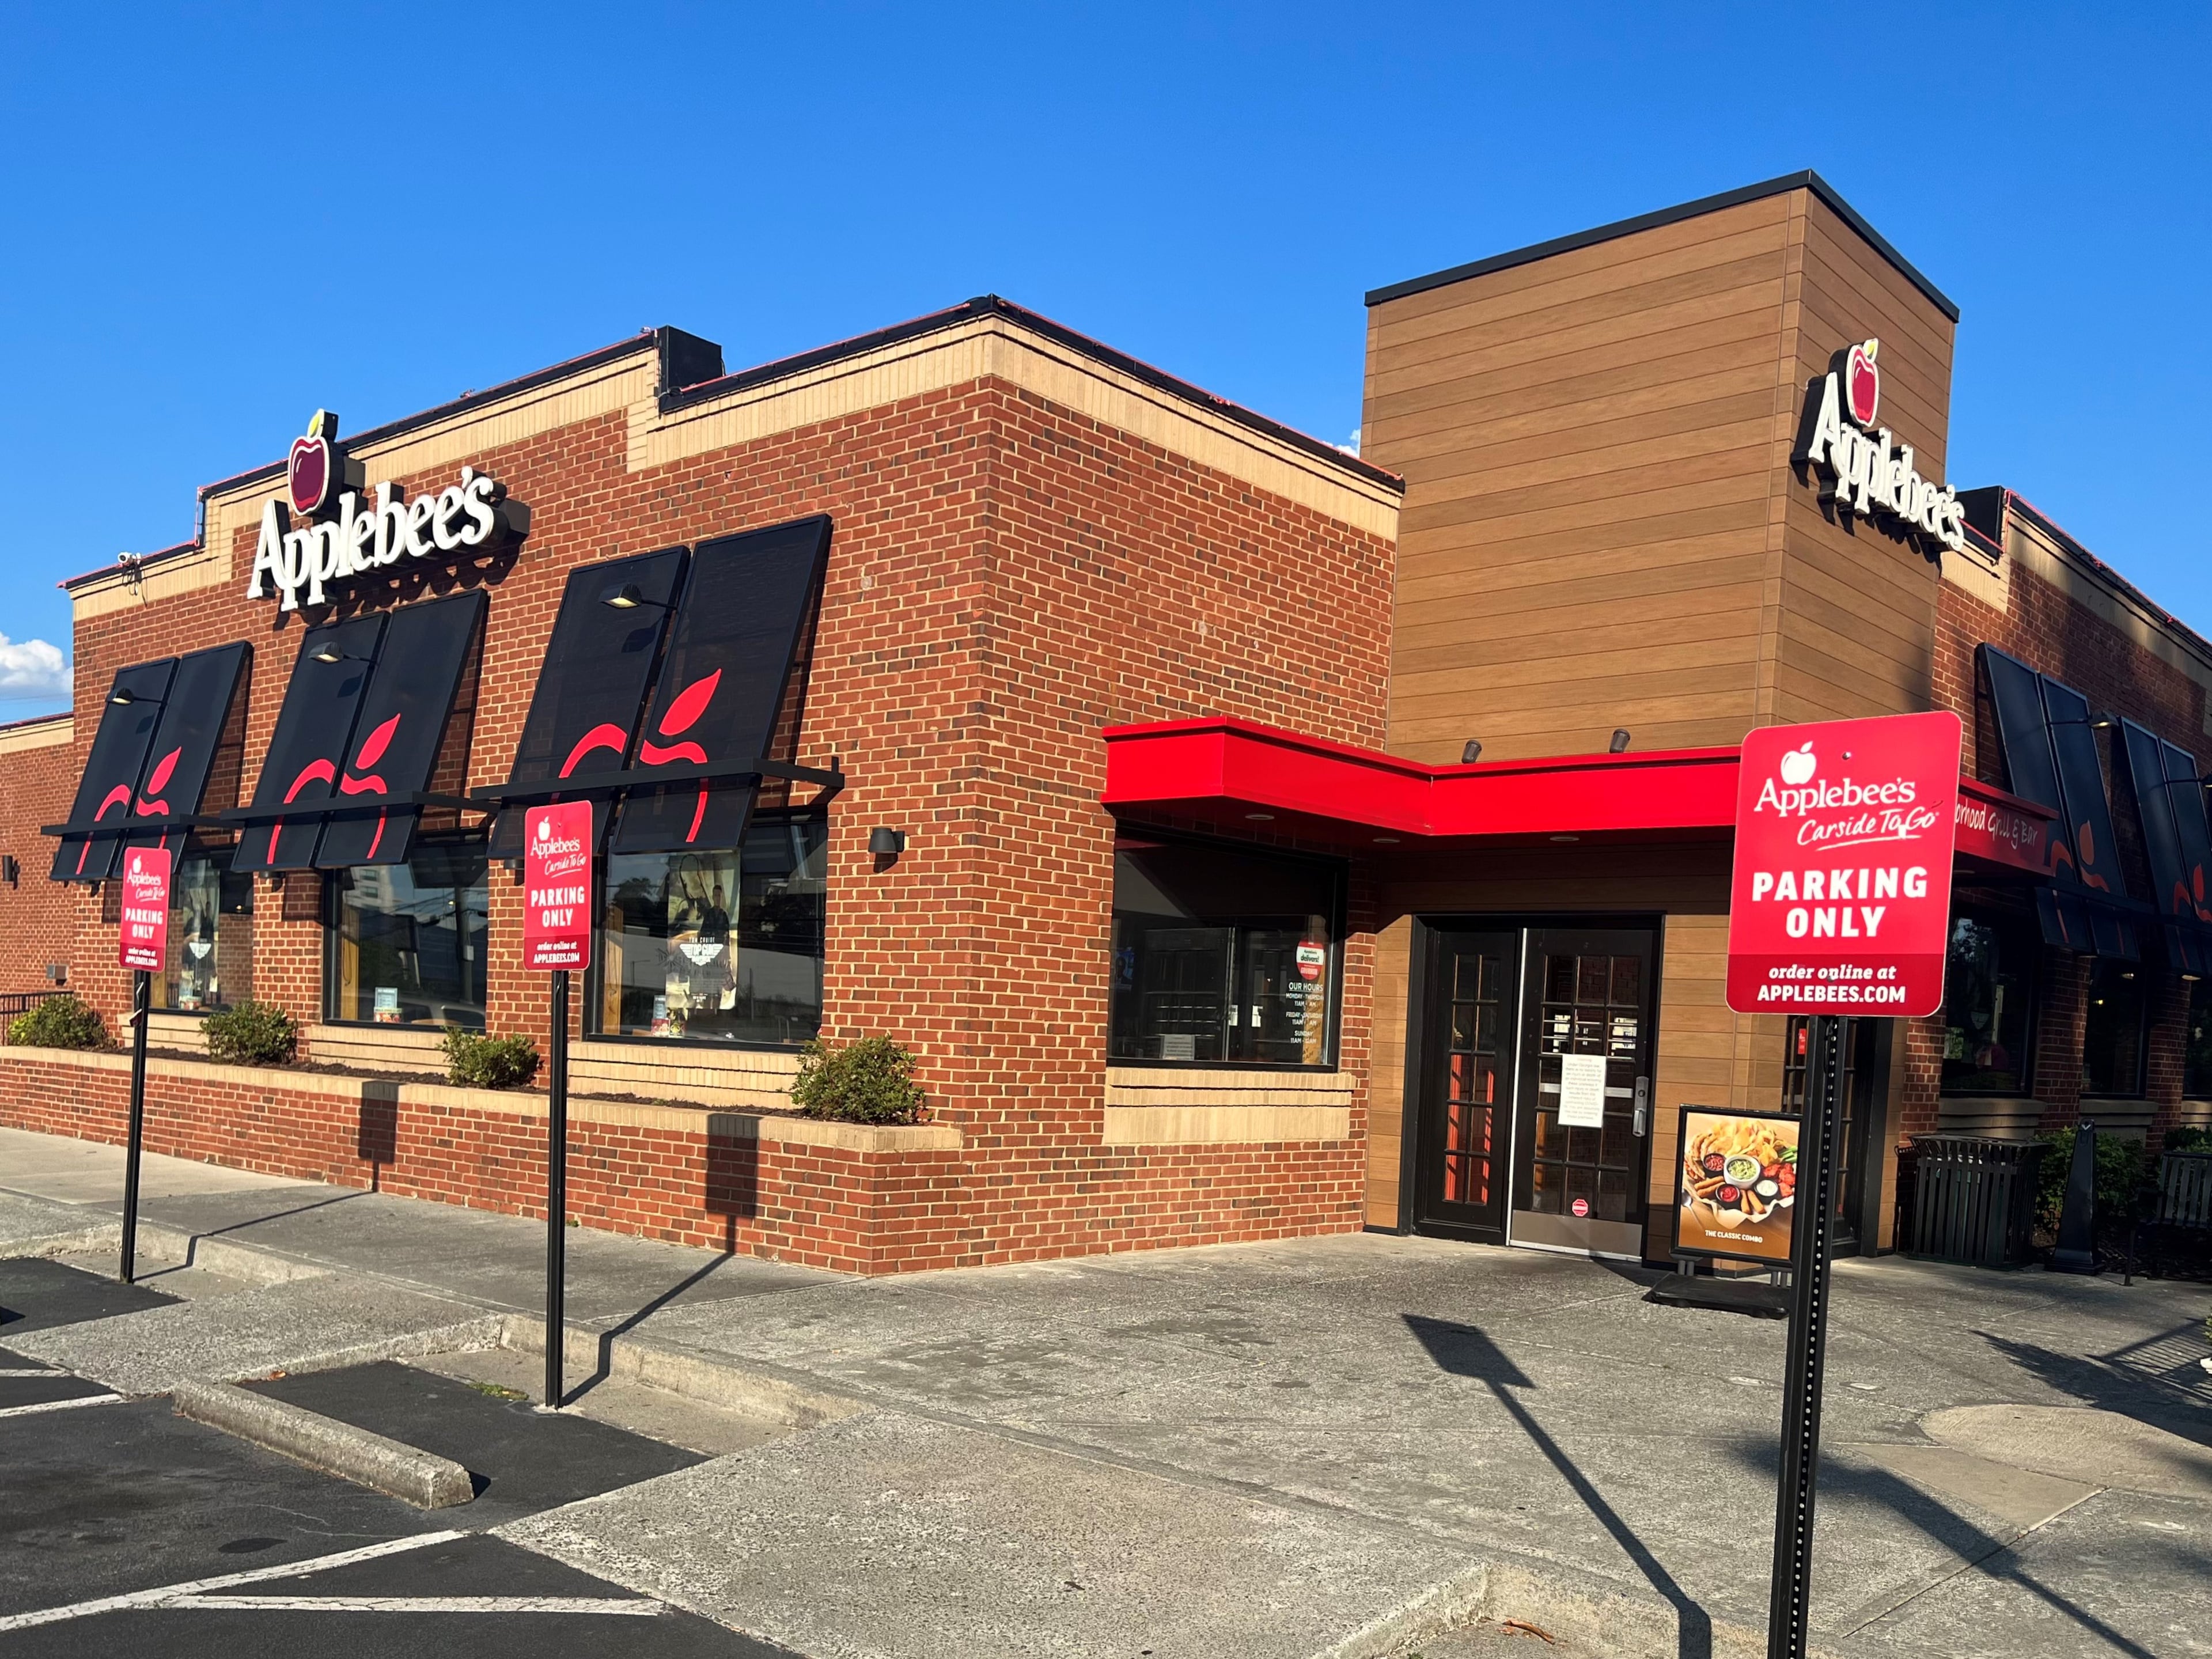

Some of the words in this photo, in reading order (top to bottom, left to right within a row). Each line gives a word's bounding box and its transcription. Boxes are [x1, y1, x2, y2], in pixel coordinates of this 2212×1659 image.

[1809, 372, 1964, 551] Applebee's
[247, 465, 495, 612] Applebee's
[1754, 778, 1916, 817] Applebee's
[1797, 813, 1876, 846] Carside
[1879, 809, 1904, 833] To
[1905, 806, 1936, 830] Go
[1988, 812, 2010, 841] Grill
[530, 836, 580, 859] Applebee's
[544, 857, 569, 875] Carside
[126, 868, 162, 887] Applebee's
[1752, 866, 1927, 902] PARKING
[531, 886, 585, 907] PARKING
[125, 907, 163, 925] PARKING
[542, 908, 573, 927] ONLY
[1786, 906, 1886, 938] ONLY
[132, 923, 154, 939] ONLY
[537, 941, 552, 950] order
[570, 941, 577, 949] at
[533, 952, 580, 964] APPLEBEES.COM
[1769, 964, 1815, 979] order
[1817, 964, 1873, 980] online
[1877, 965, 1896, 979] at
[1758, 986, 1906, 1003] APPLEBEES.COM
[1717, 1232, 1741, 1240] CLASSIC
[1741, 1234, 1763, 1243] COMBO
